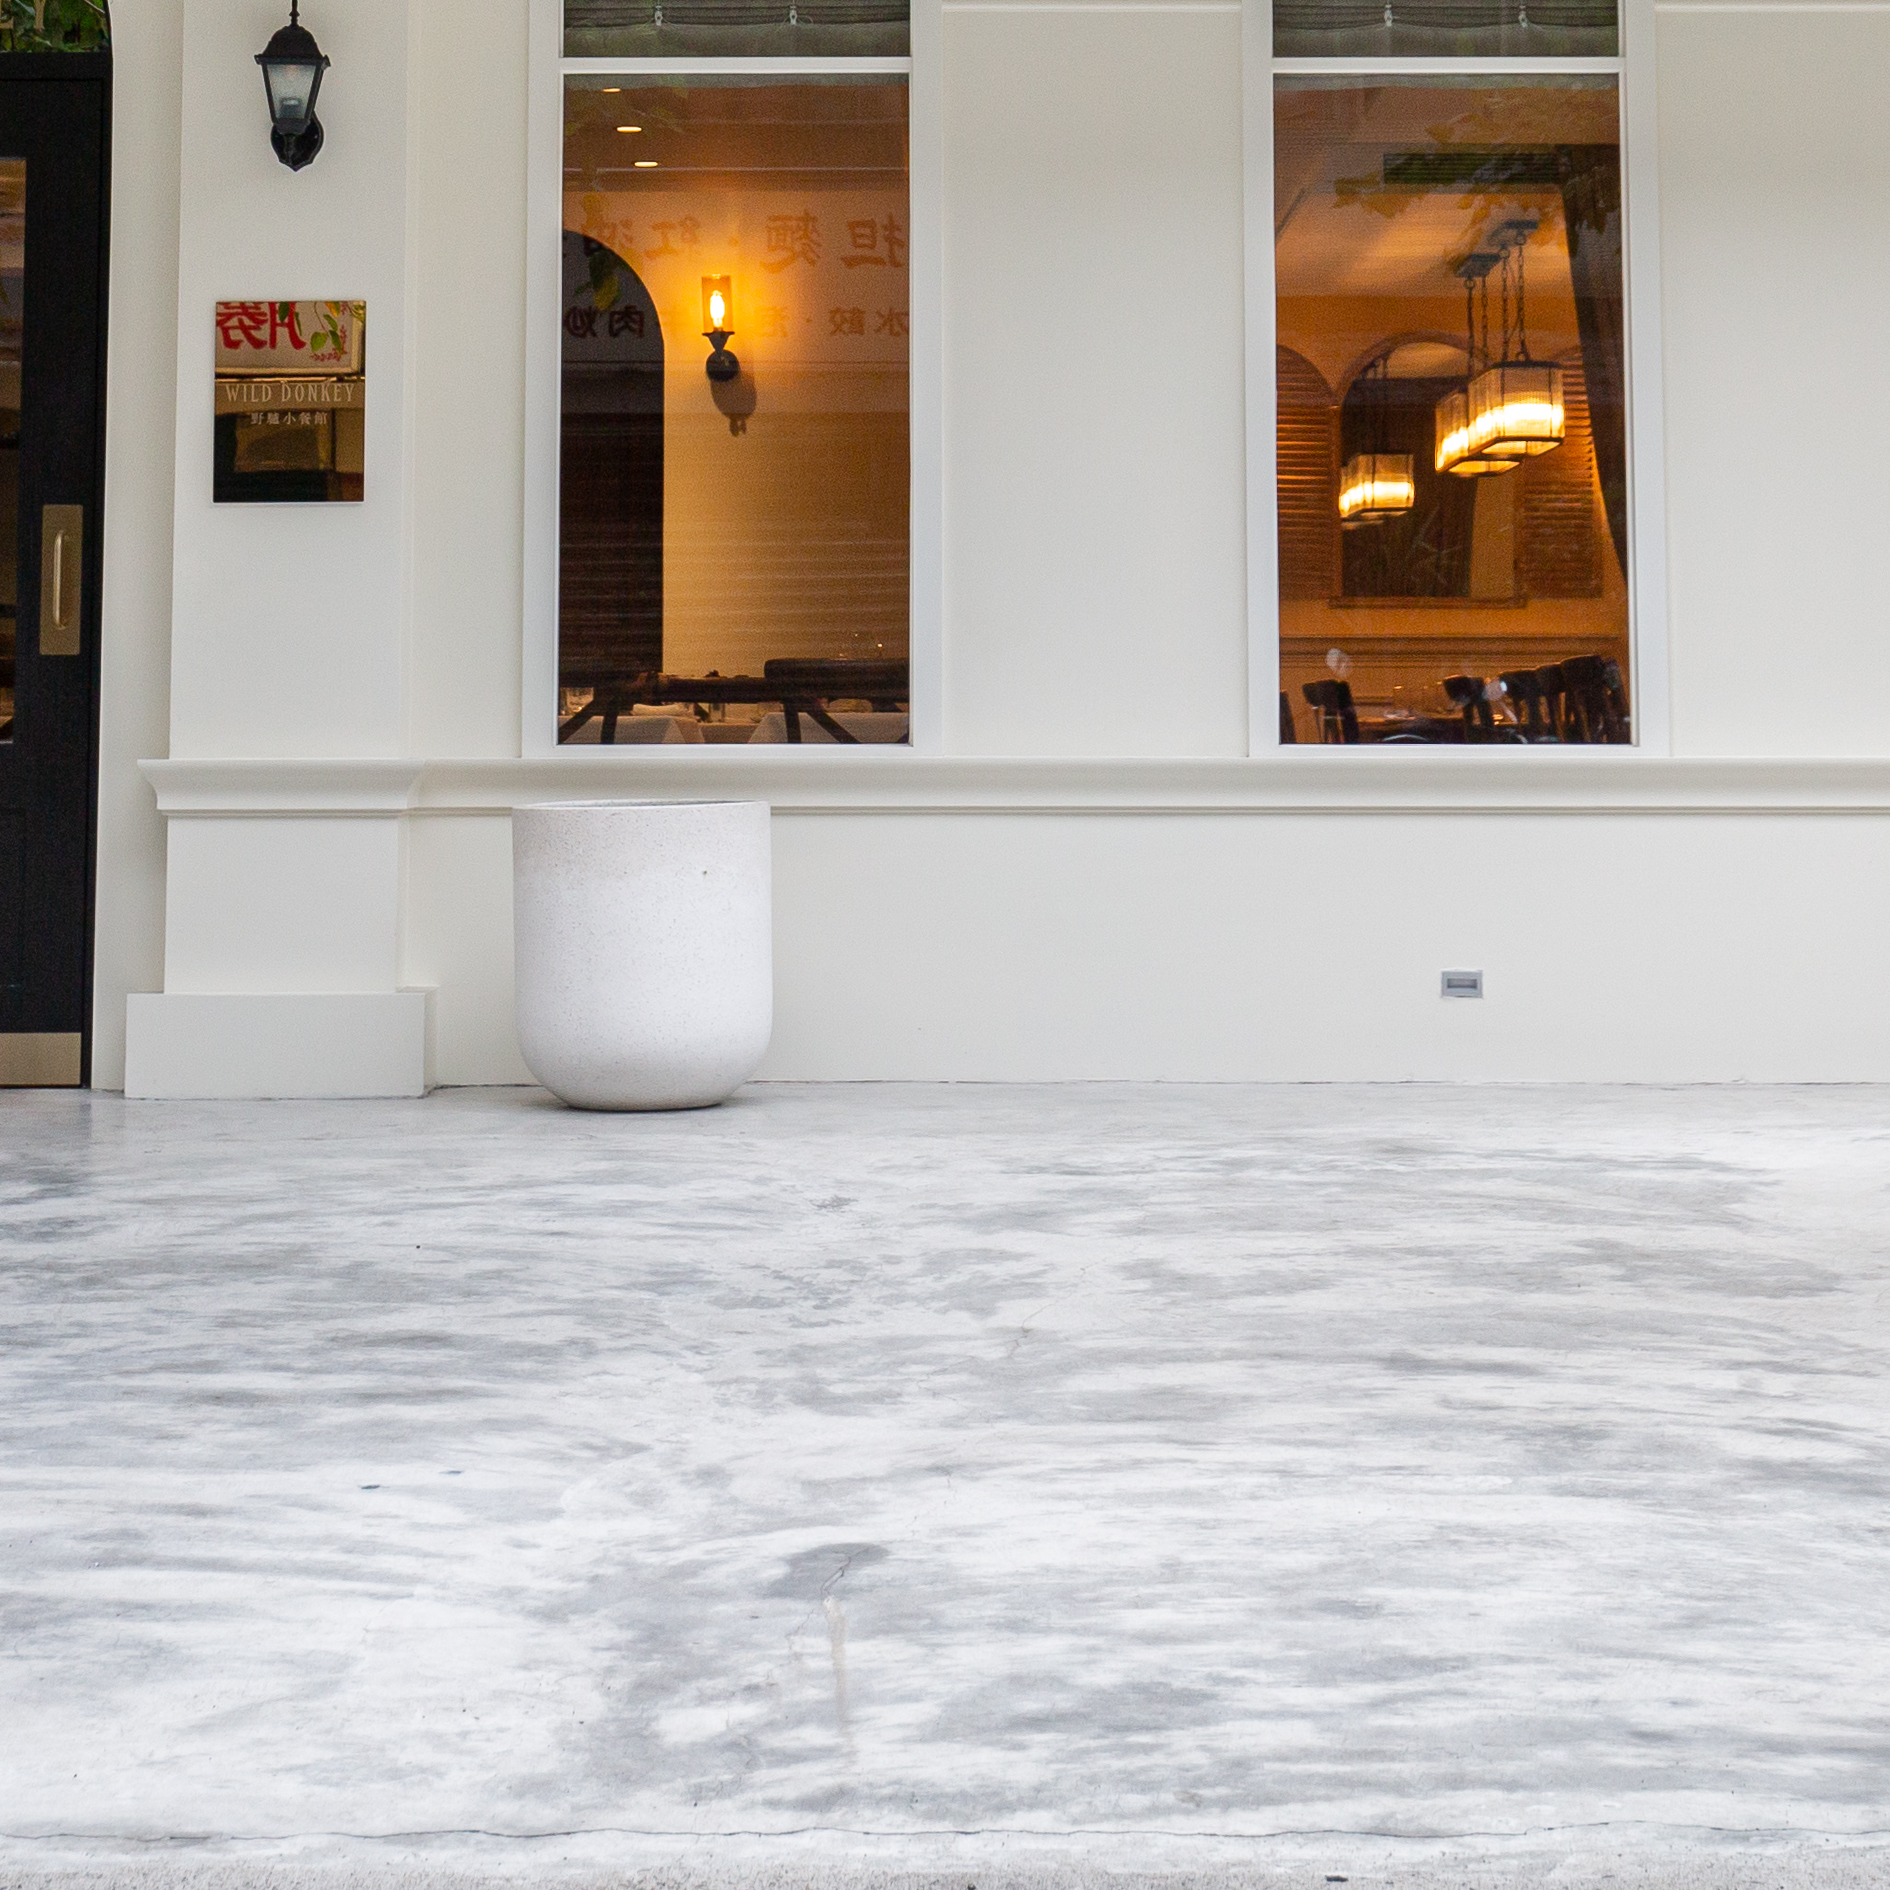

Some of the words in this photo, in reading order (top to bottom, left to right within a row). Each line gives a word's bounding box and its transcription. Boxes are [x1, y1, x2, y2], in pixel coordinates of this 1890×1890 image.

[225, 383, 272, 402] WILD
[281, 382, 355, 402] DONKEY
[250, 411, 328, 425] 野驢小餐館
